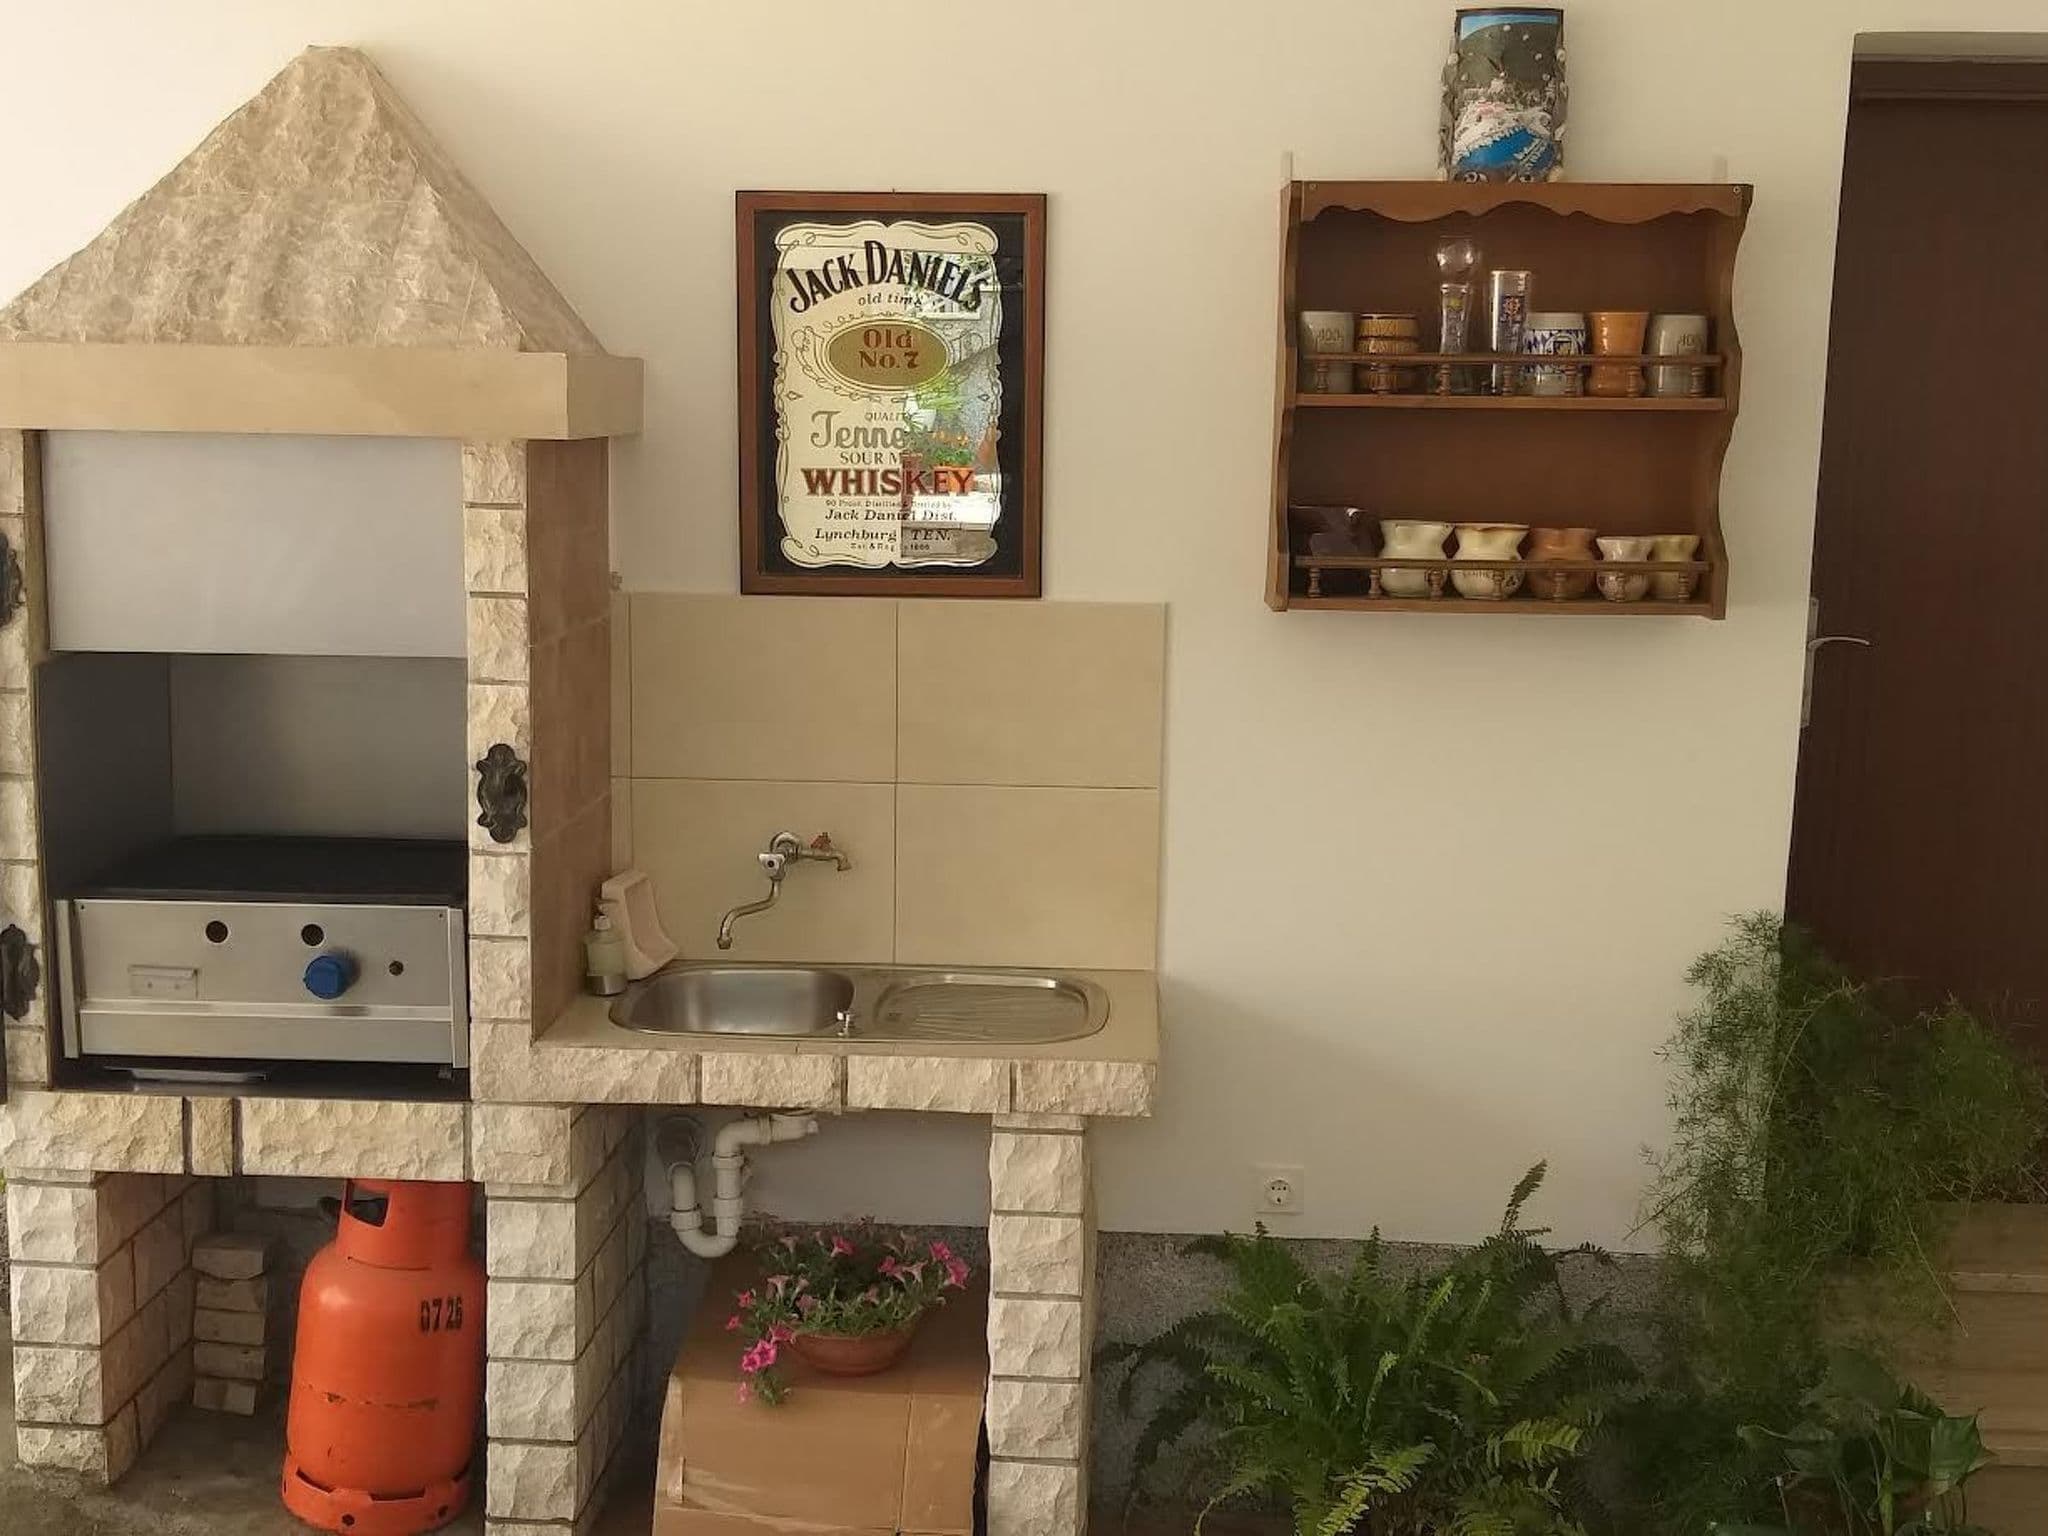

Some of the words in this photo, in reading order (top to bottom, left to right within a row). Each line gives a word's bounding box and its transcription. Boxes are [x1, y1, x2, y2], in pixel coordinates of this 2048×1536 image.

[786, 253, 864, 313] JACK
[858, 292, 882, 305] old
[863, 328, 913, 349] Old
[840, 452, 884, 465] SOUR
[801, 467, 975, 496] WHISKEY
[825, 509, 859, 521] Jack
[864, 509, 916, 521] Daniel
[815, 528, 898, 543] Lynchburg
[911, 530, 951, 541] TEN.
